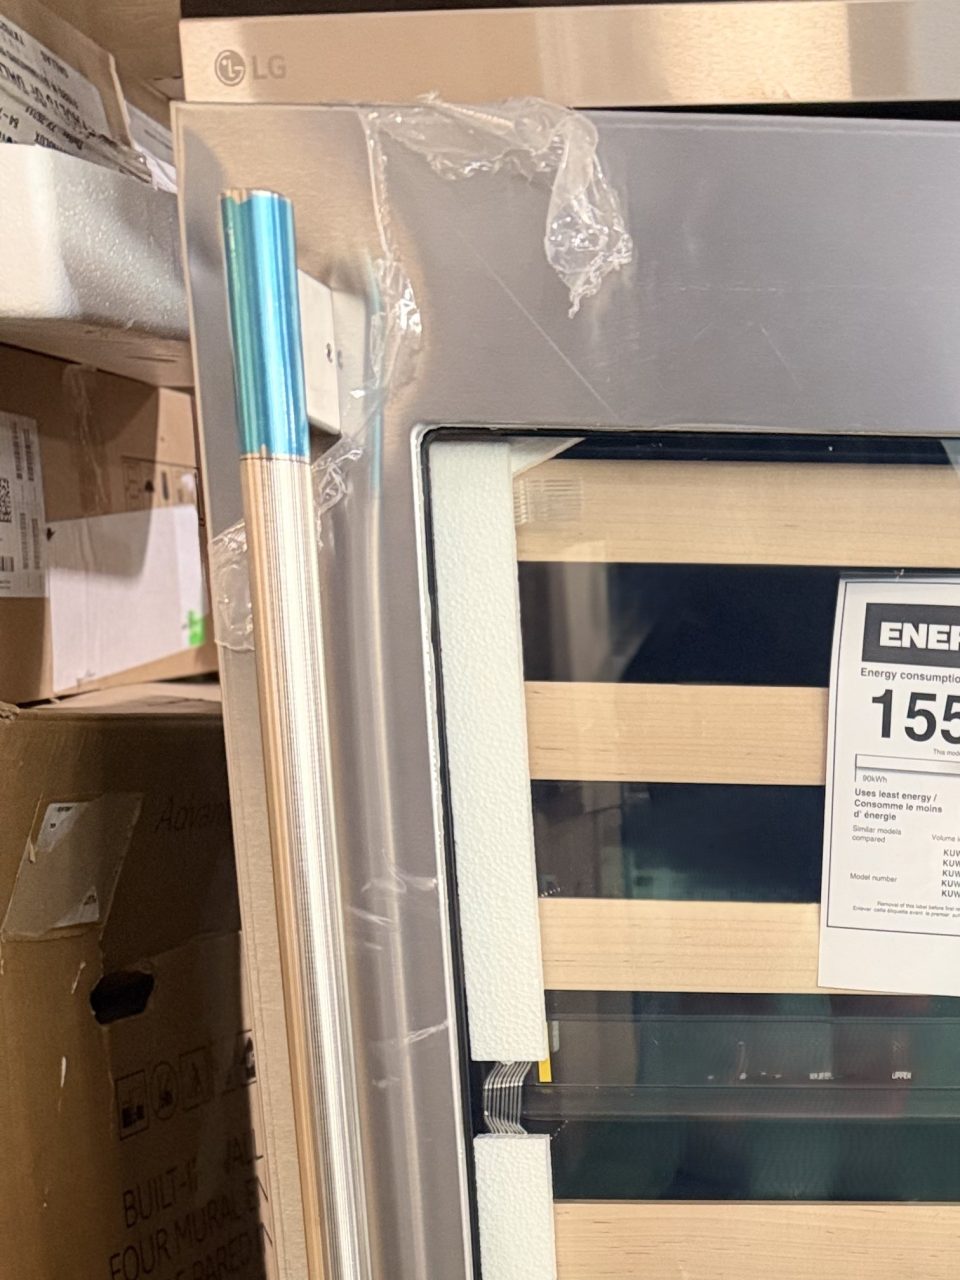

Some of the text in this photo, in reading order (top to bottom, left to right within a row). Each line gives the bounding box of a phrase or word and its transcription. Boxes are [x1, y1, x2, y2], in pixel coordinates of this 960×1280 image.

[251, 53, 288, 80] LG
[860, 667, 897, 681] Energy
[933, 748, 948, 756] This
[855, 788, 876, 797] Uses
[879, 790, 900, 799] least
[901, 792, 932, 803] energy
[854, 799, 943, 813] Consomme le moins
[864, 811, 897, 822] énergie
[852, 824, 902, 835] Similar models
[851, 835, 886, 844] compared
[932, 834, 956, 842] Volume
[849, 872, 897, 883] Model number
[174, 1190, 243, 1247] MURAL
